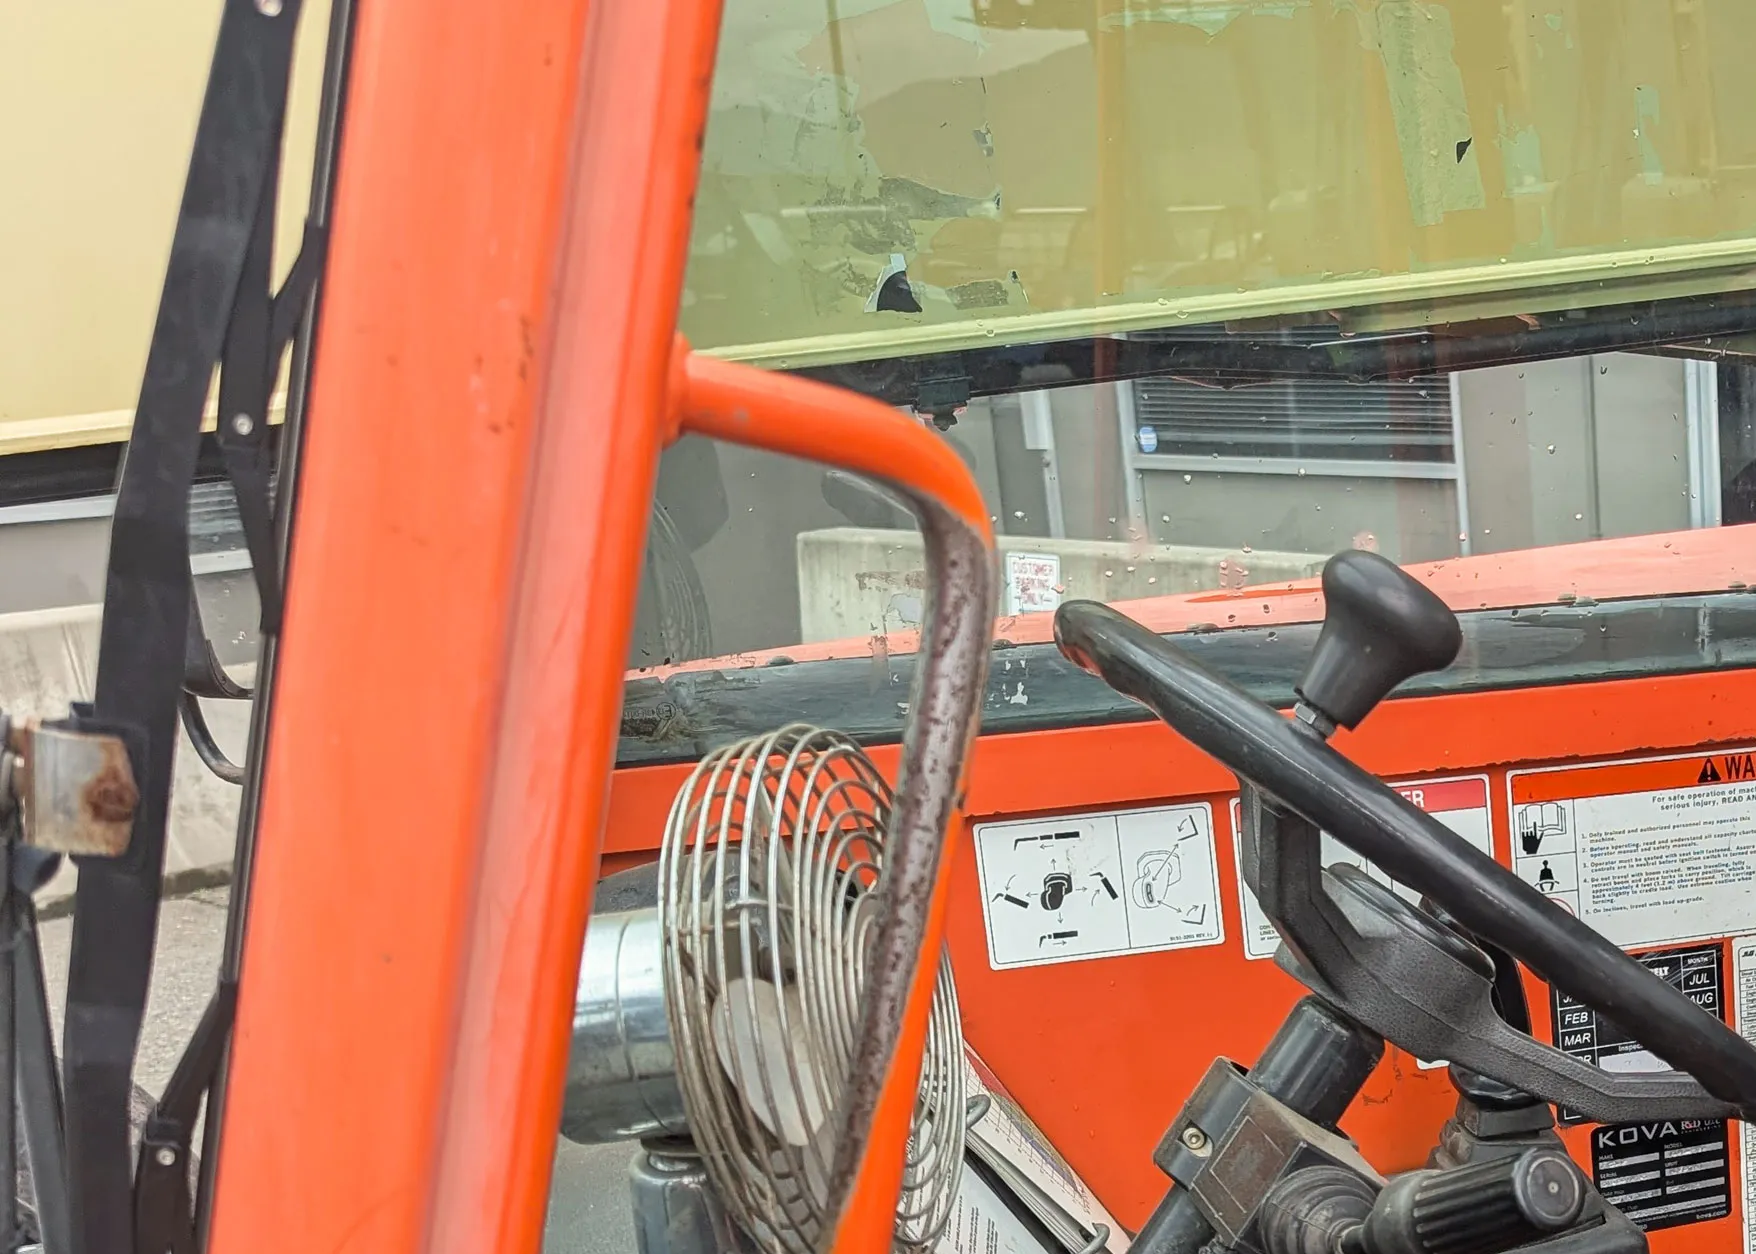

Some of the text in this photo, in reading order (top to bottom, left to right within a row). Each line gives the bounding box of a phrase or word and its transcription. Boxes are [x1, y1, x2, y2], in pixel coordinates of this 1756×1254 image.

[1652, 795, 1664, 803] For
[1668, 793, 1684, 801] safe
[1687, 789, 1725, 800] operation
[1660, 801, 1690, 810] serious
[1693, 798, 1718, 808] injury,
[1721, 795, 1743, 804] READ
[1687, 957, 1709, 965] MONTH
[1649, 966, 1670, 977] ELT
[1689, 973, 1710, 986] JUL
[1689, 992, 1714, 1005] AUG
[1564, 1011, 1589, 1025] FEB
[1564, 1032, 1591, 1046] MAR
[1618, 1043, 1643, 1052] Inspec
[1574, 1054, 1592, 1065] PR
[1598, 1121, 1678, 1149] KOVA
